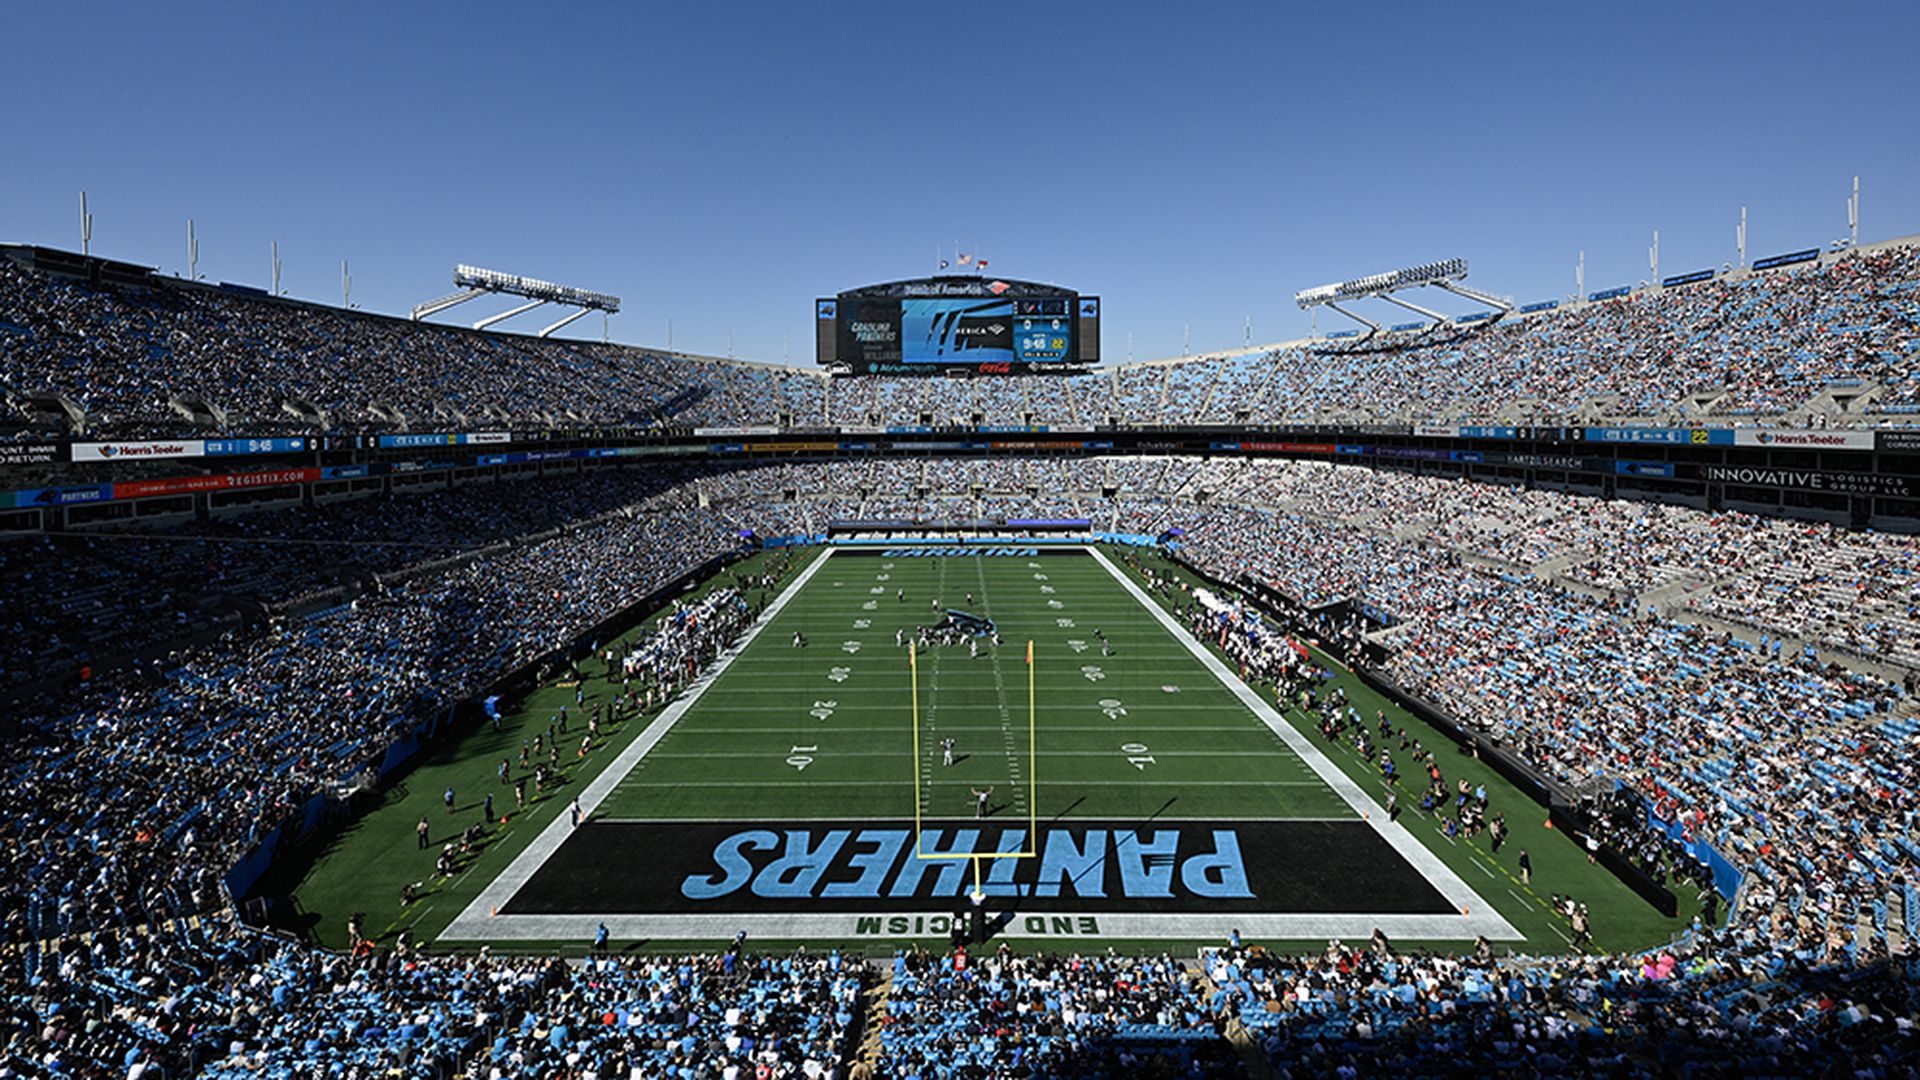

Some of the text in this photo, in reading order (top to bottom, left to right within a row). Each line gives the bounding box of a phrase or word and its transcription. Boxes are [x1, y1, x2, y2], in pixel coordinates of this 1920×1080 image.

[1692, 430, 1709, 443] 22
[1775, 434, 1846, 445] Harris Teeter
[120, 445, 184, 456] Harris Teeter
[1708, 467, 1904, 488] INNOVATIVE LOGISTICS
[1829, 483, 1876, 493] GROUP
[786, 745, 818, 766] 10
[1121, 743, 1156, 766] 10
[680, 829, 1257, 899] PANTHERS
[856, 916, 1100, 934] END CISM
